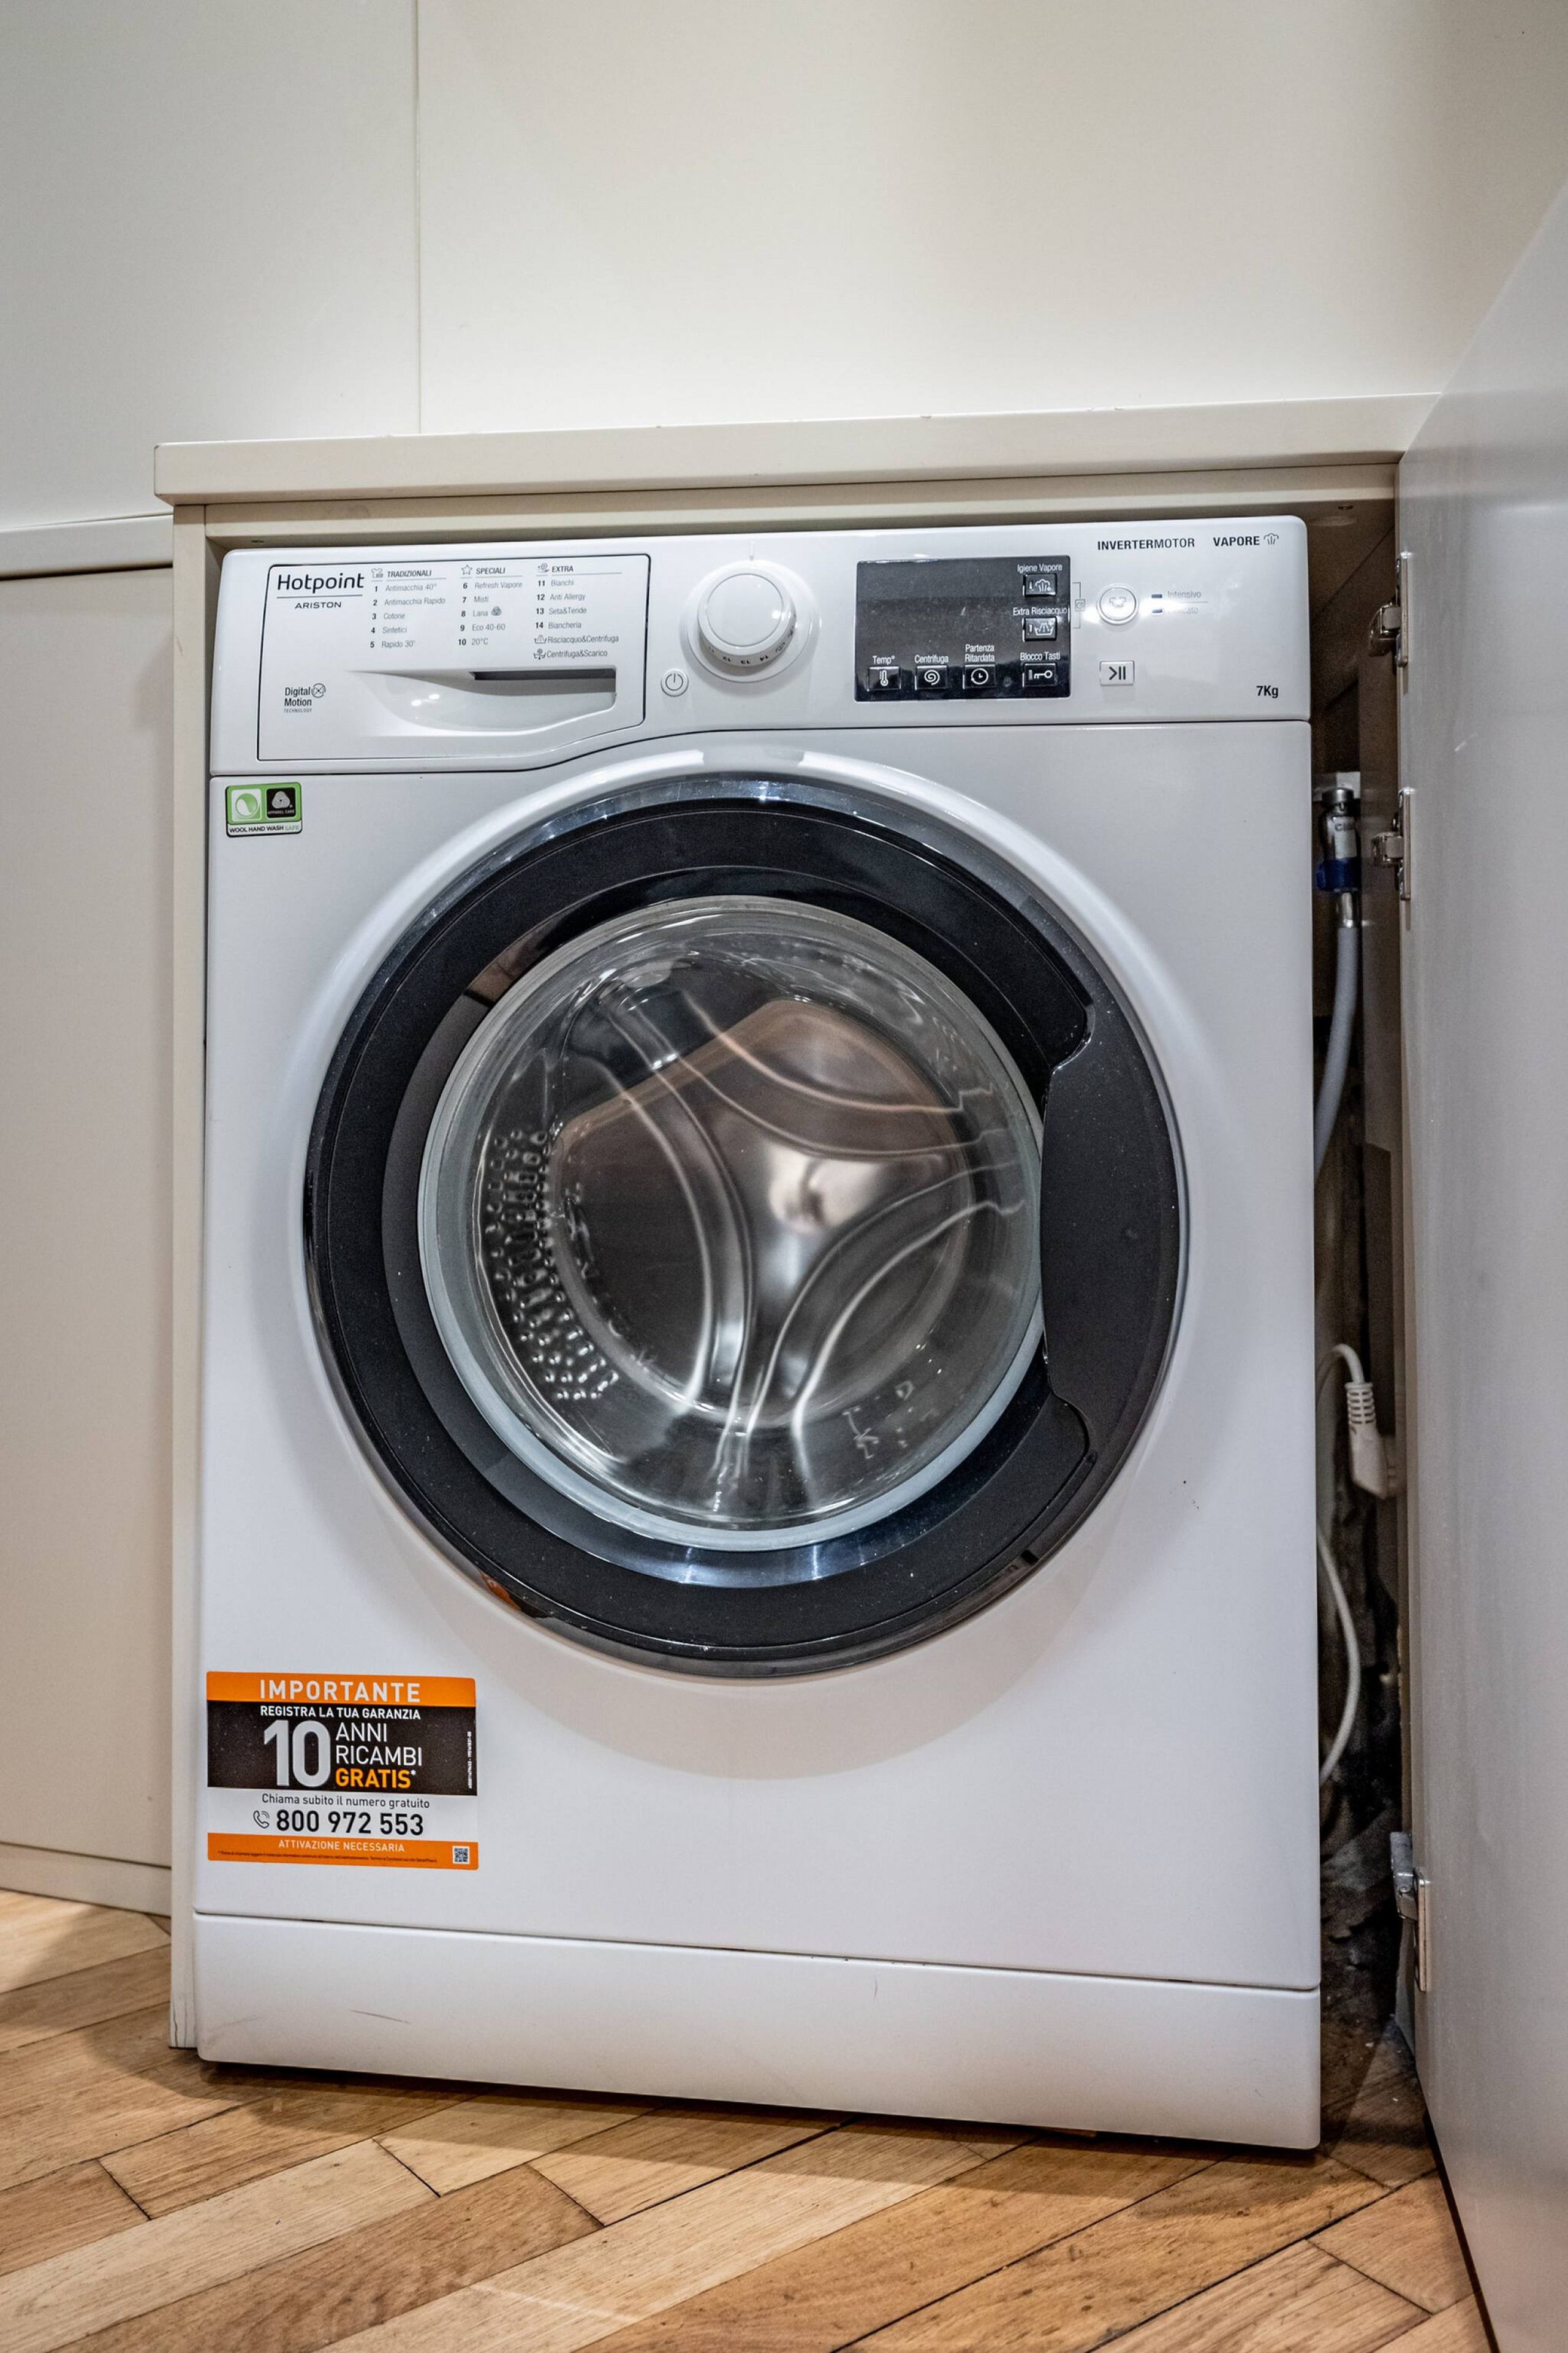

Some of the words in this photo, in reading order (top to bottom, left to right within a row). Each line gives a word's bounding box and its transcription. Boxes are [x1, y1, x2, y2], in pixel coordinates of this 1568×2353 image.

[1097, 538, 1195, 550] INVERTERMOTOR
[1213, 536, 1260, 547] VAPORE
[1017, 564, 1038, 574] Igiene
[1039, 563, 1063, 572] Vapore
[277, 572, 365, 594] Hotpoint
[564, 593, 586, 602] Allergy
[1167, 590, 1202, 599] Intensivo
[1013, 607, 1030, 616] Extra
[1031, 606, 1067, 616] Risciacquo
[382, 640, 403, 649] Rapido
[547, 635, 619, 645] Risciacquo&Centrifuga
[965, 643, 994, 653] Partenza
[547, 650, 608, 659] Centrifuga&Scarico
[914, 654, 949, 664] Centrifuga
[965, 653, 995, 662] Ritardata
[1020, 652, 1043, 661] Blocco
[1043, 651, 1061, 661] Tasti
[284, 687, 311, 697] Digital
[1257, 685, 1279, 699] 7Kg
[284, 697, 312, 707] Motion
[260, 1679, 420, 1702] IMPORTANTE
[260, 1705, 316, 1717] REGISTRA
[319, 1707, 334, 1718] LA
[336, 1707, 360, 1718] TUA
[362, 1708, 421, 1720] GARANZIA
[336, 1722, 387, 1742] ANNI
[263, 1719, 331, 1787] 10
[336, 1745, 422, 1766] RICAMBI
[262, 1793, 300, 1805] Chiama
[303, 1795, 334, 1805] subito
[336, 1796, 343, 1806] il
[346, 1797, 386, 1808] numero
[389, 1798, 430, 1809] gratuito
[276, 1809, 319, 1832] 800
[328, 1811, 371, 1834] 972
[380, 1813, 423, 1836] 553
[278, 1839, 339, 1850] ATTIVAZIONE
[343, 1841, 405, 1852] NECESSARIA
